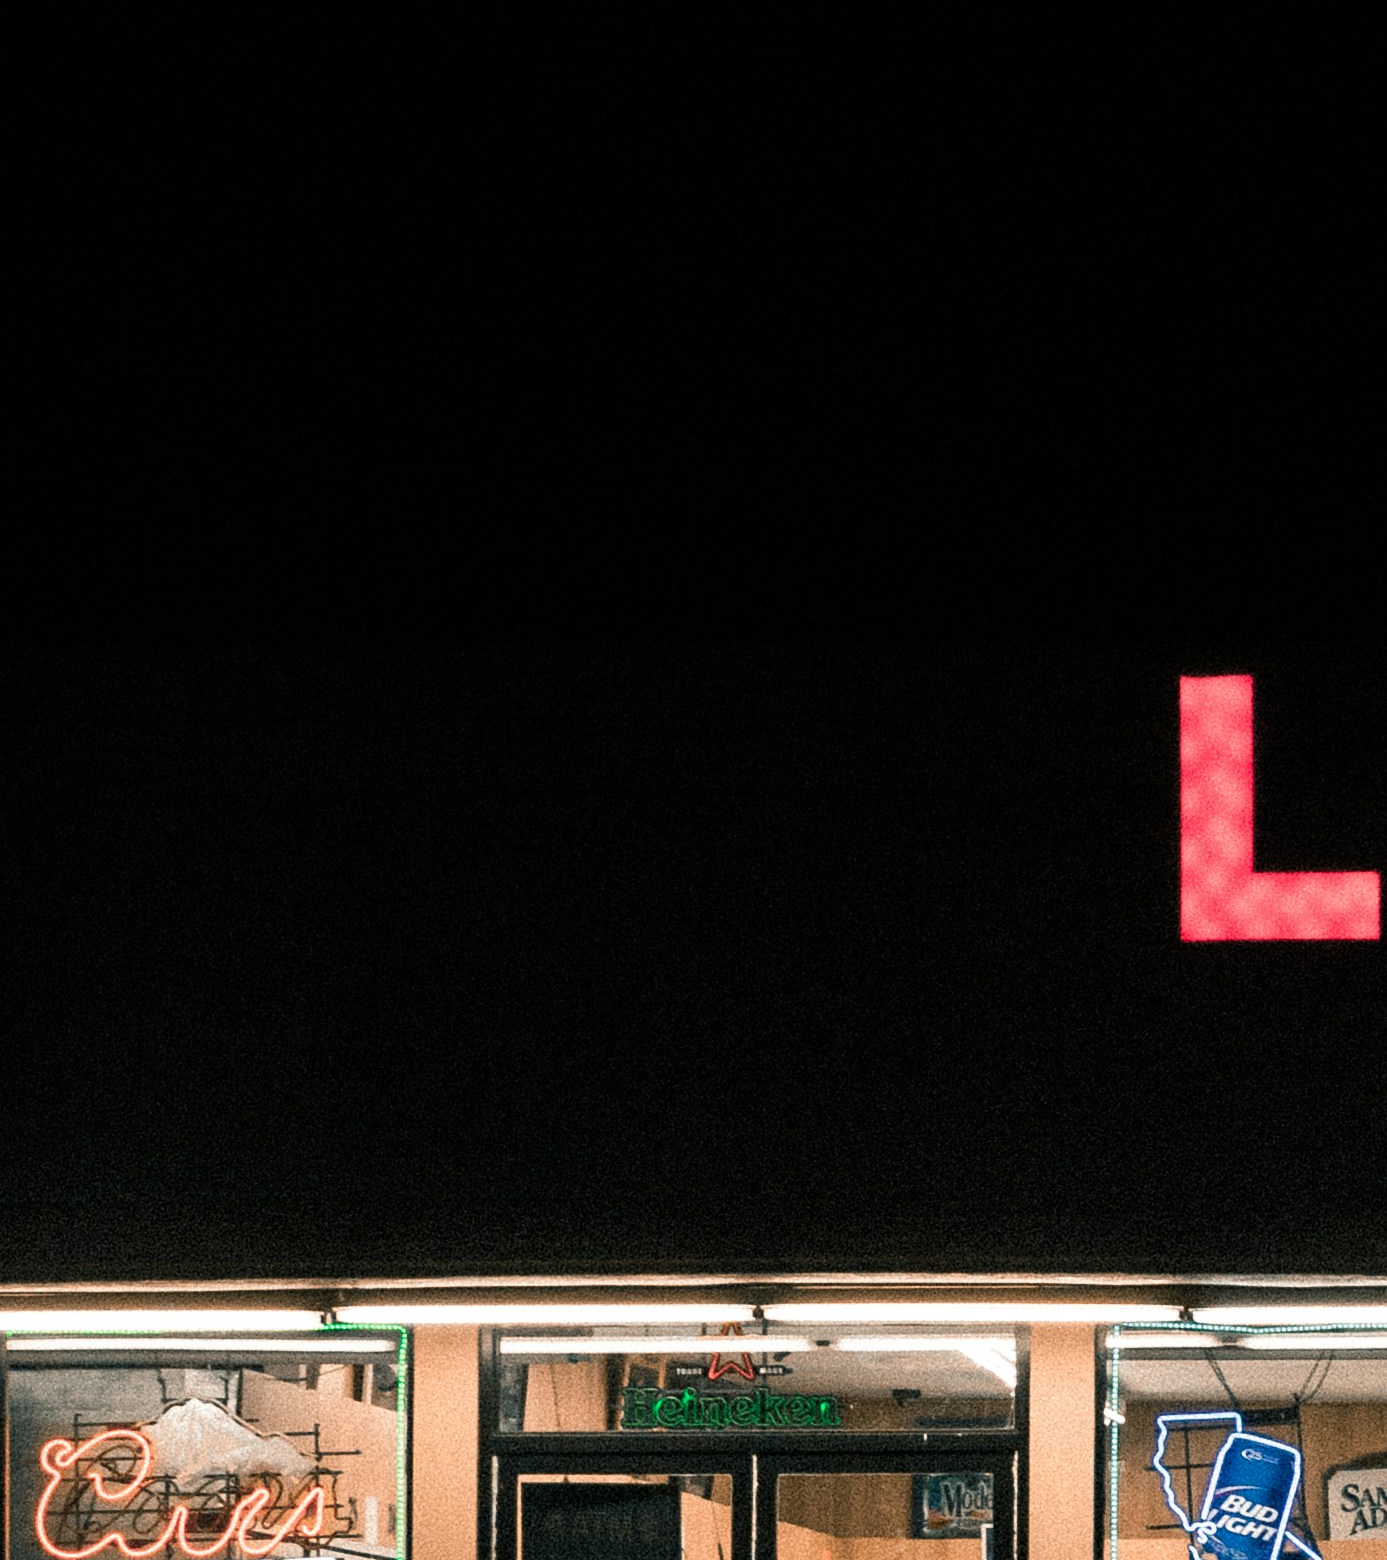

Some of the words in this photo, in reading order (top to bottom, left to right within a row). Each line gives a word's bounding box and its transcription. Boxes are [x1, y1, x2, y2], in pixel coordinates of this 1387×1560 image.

[621, 1387, 842, 1427] Heineken
[1219, 1495, 1279, 1523] BUD
[1206, 1510, 1278, 1542] LIGHT
